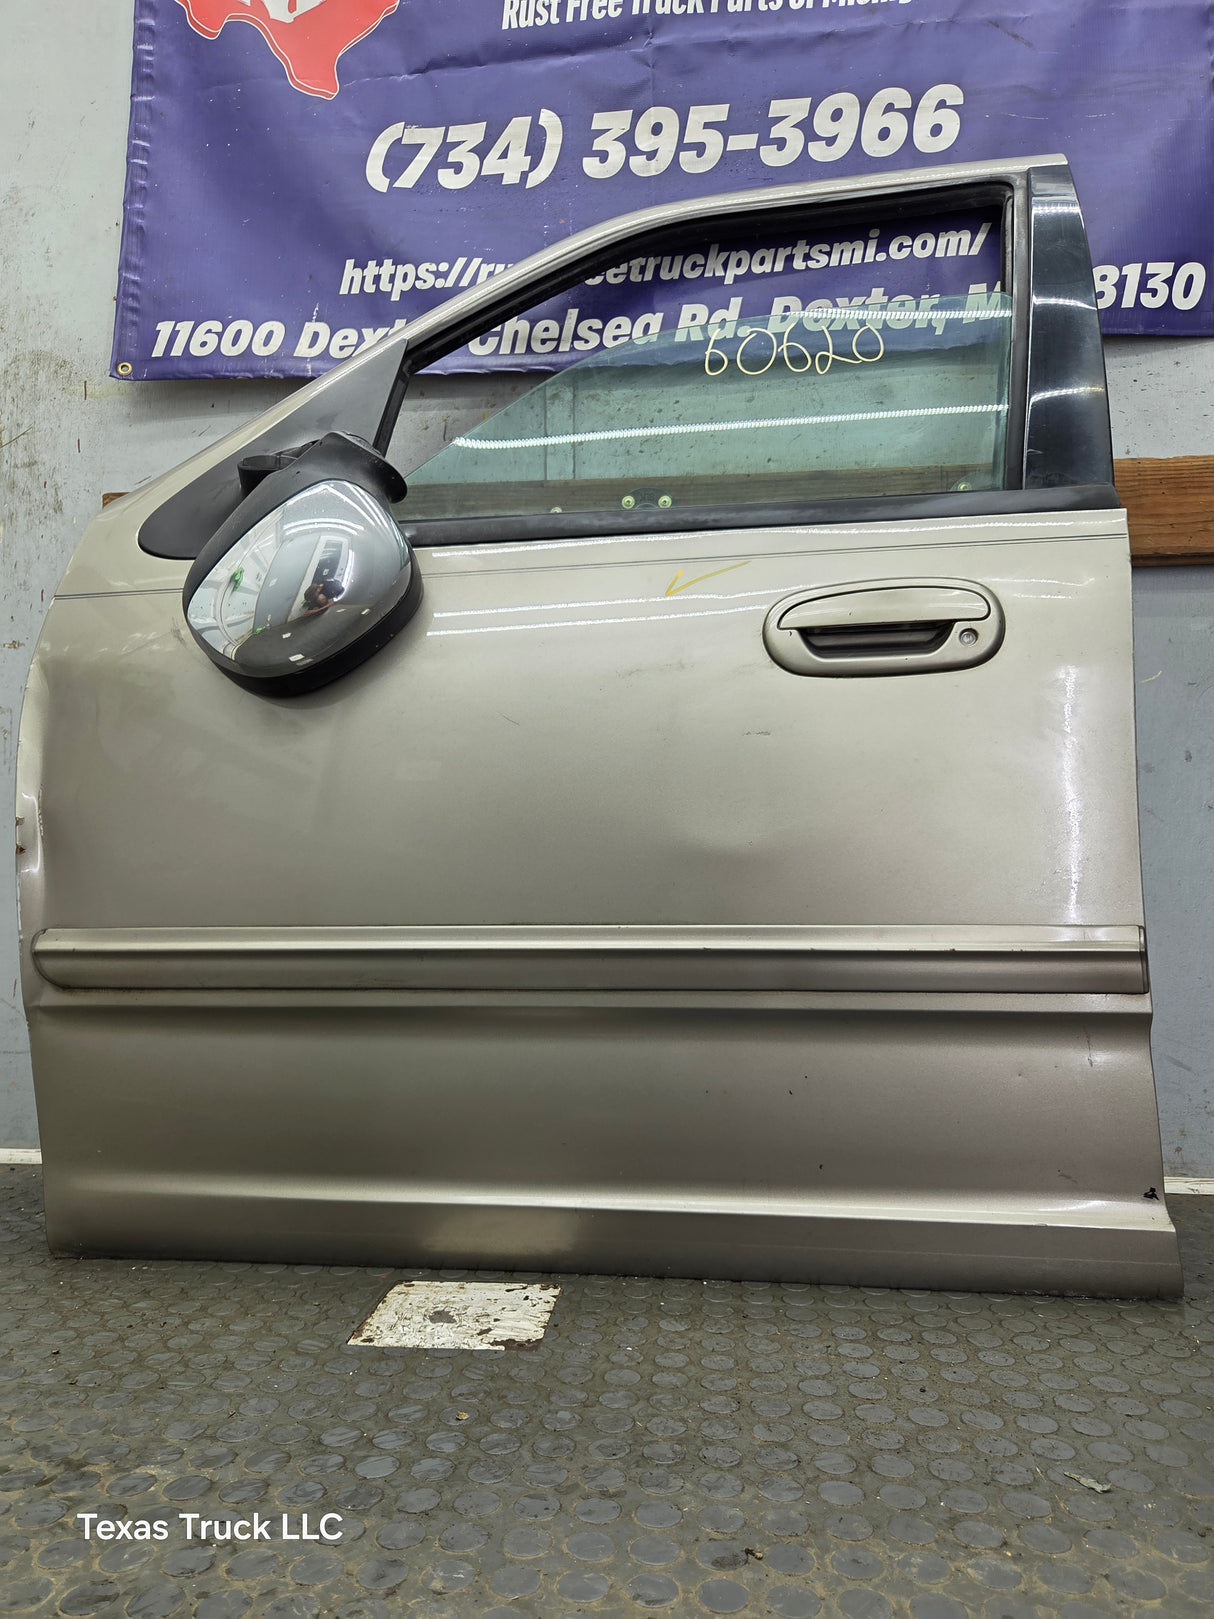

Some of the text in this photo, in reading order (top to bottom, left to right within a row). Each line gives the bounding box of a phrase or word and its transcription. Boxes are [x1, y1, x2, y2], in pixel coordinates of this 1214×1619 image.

[501, 0, 561, 30] Rust
[565, 0, 623, 22] Free
[365, 84, 965, 192] (734) 395-3966
[151, 319, 286, 357] 11600
[293, 318, 407, 359] Dex
[674, 296, 750, 342] Rd.
[767, 287, 948, 335] Dexter,
[1092, 261, 1207, 311] 8130
[704, 322, 885, 376] 60620
